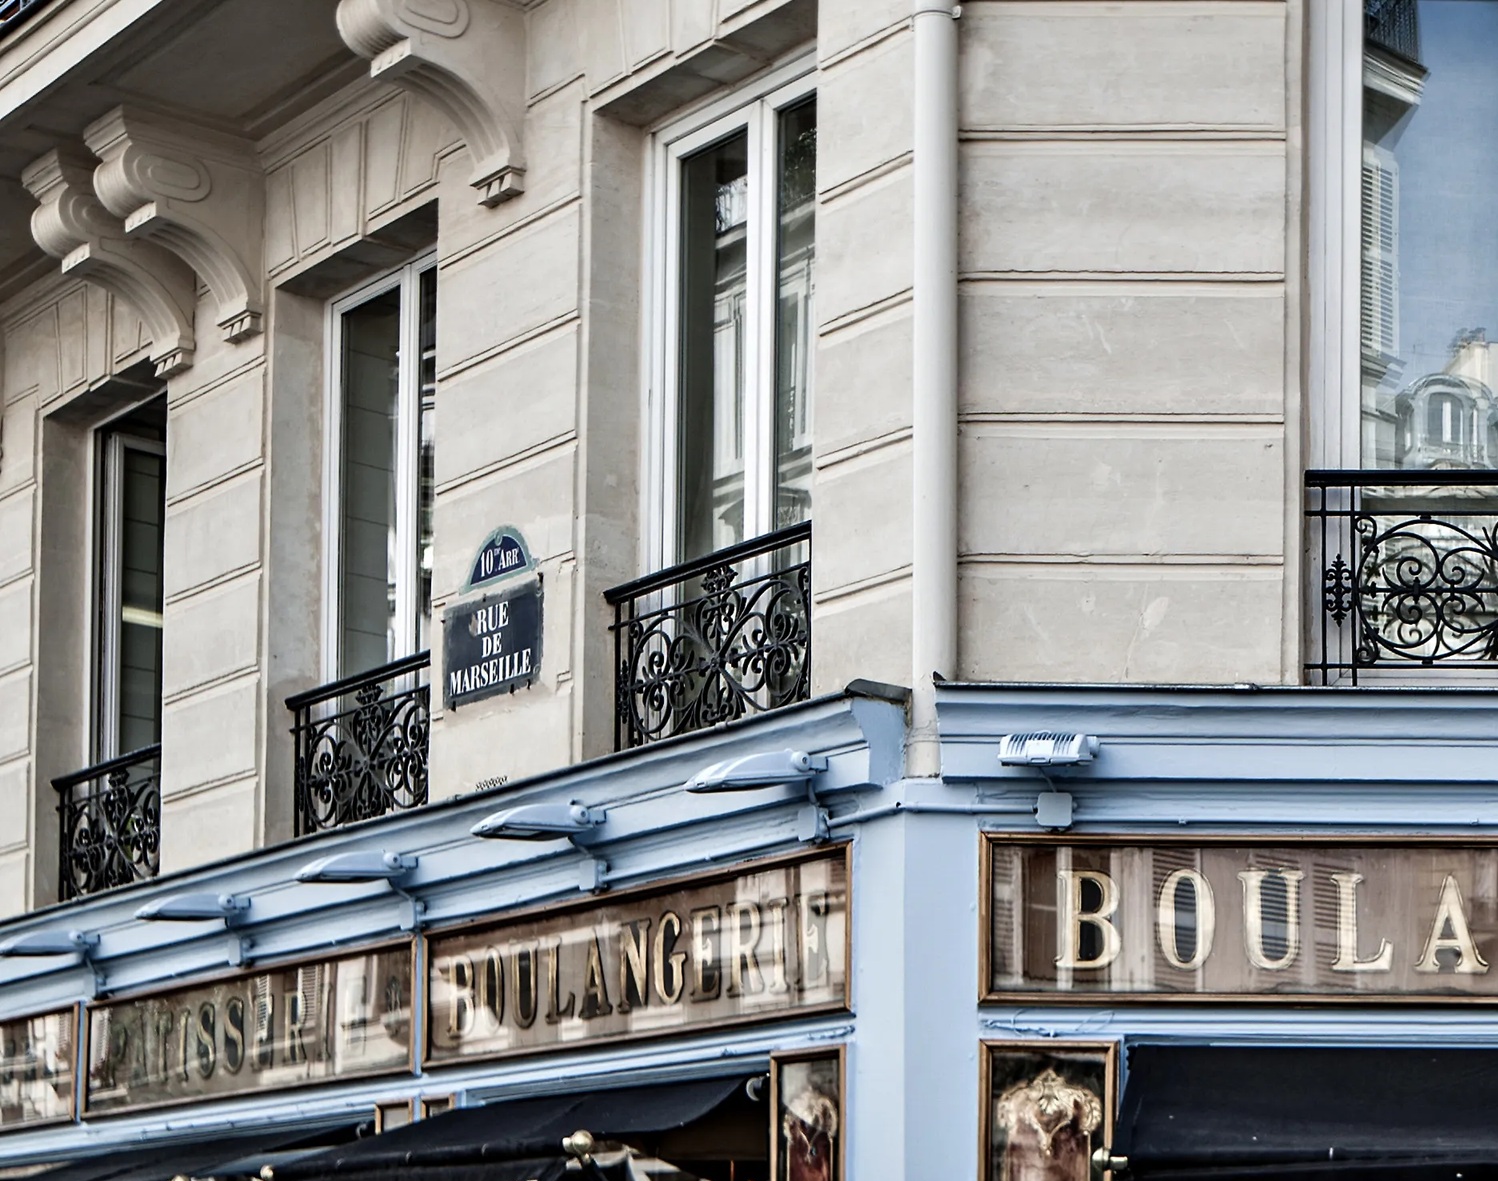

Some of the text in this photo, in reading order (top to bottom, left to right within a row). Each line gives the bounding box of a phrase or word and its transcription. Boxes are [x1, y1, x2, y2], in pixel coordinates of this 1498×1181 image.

[476, 601, 510, 635] RUE
[481, 632, 502, 658] DE
[449, 648, 532, 697] MARSEILLE
[446, 890, 831, 1040] BOULANGERIE
